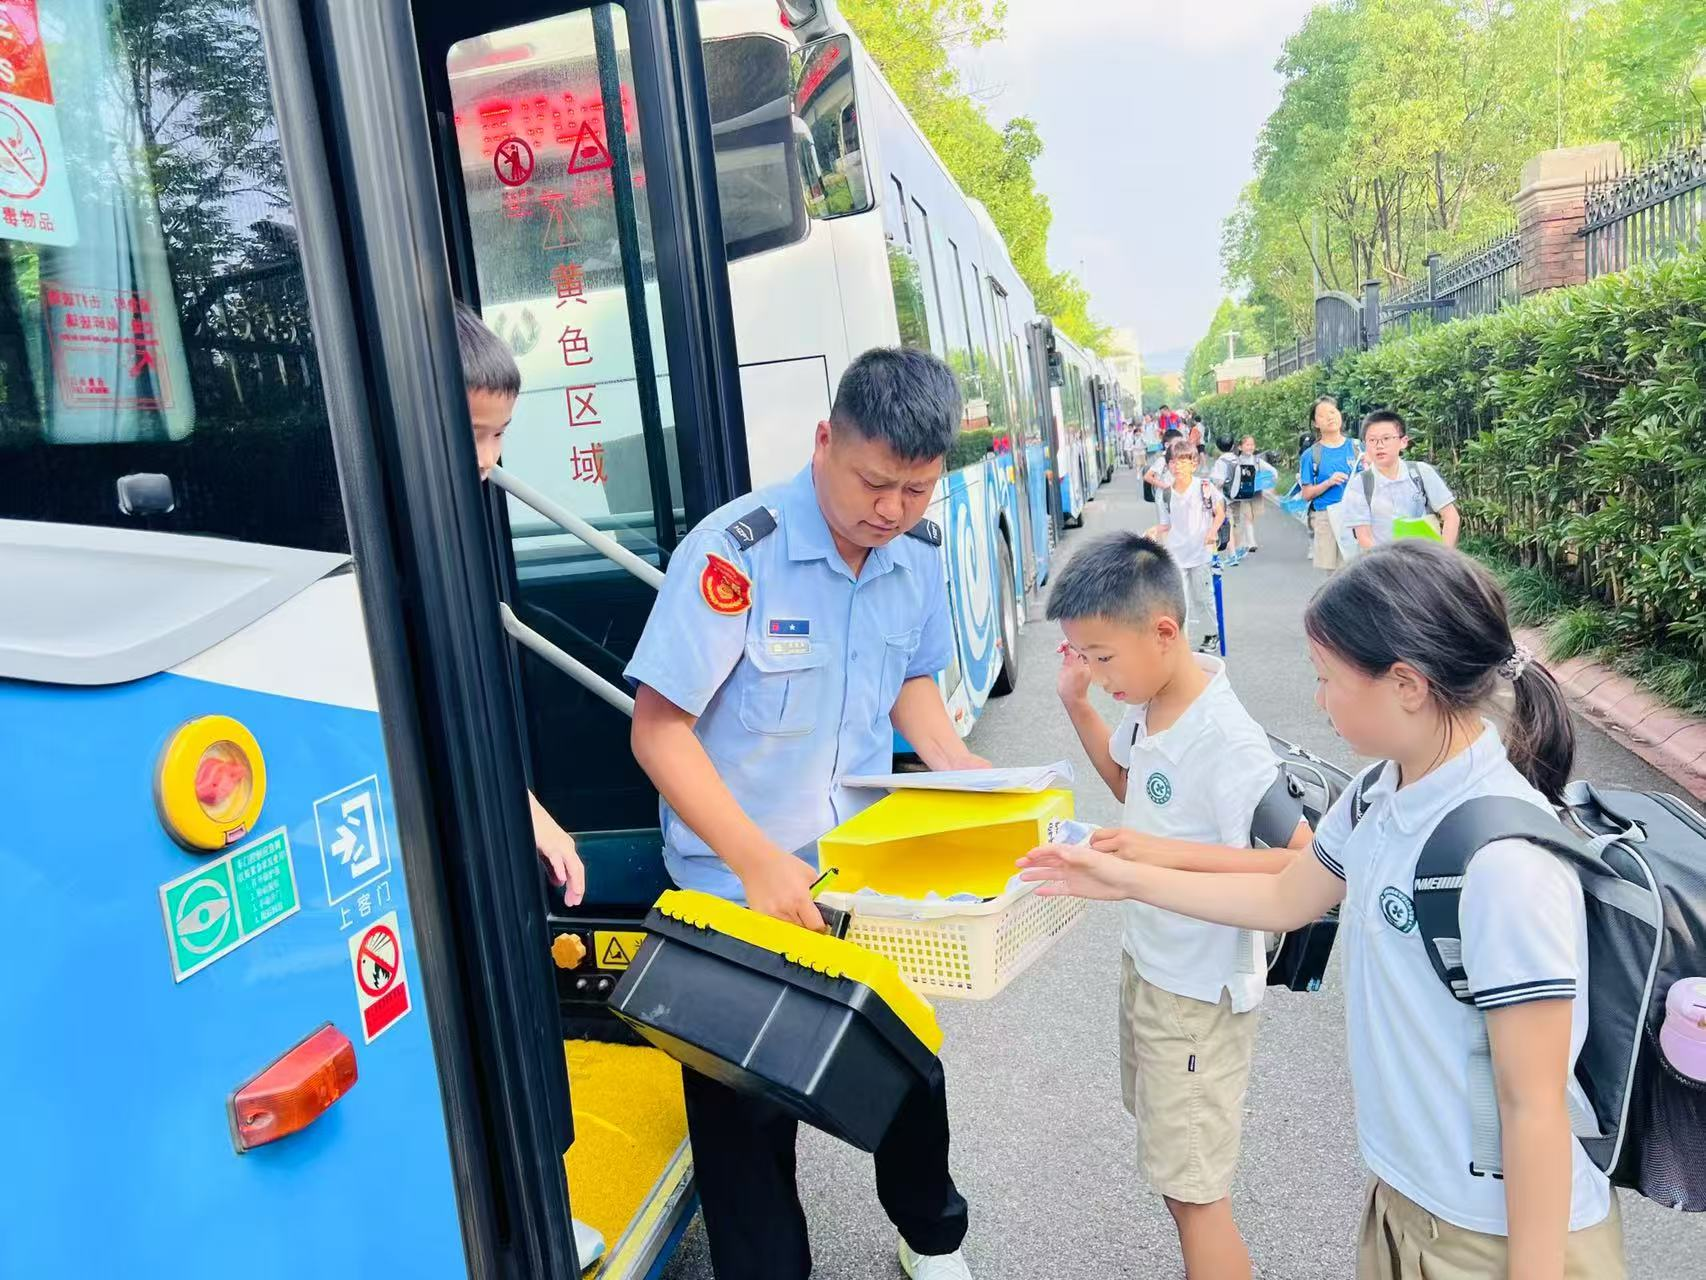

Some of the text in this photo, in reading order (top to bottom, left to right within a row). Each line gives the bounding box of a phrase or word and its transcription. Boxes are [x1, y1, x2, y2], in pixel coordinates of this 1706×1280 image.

[551, 262, 608, 484] 黄色区域
[340, 880, 391, 931] 上客门
